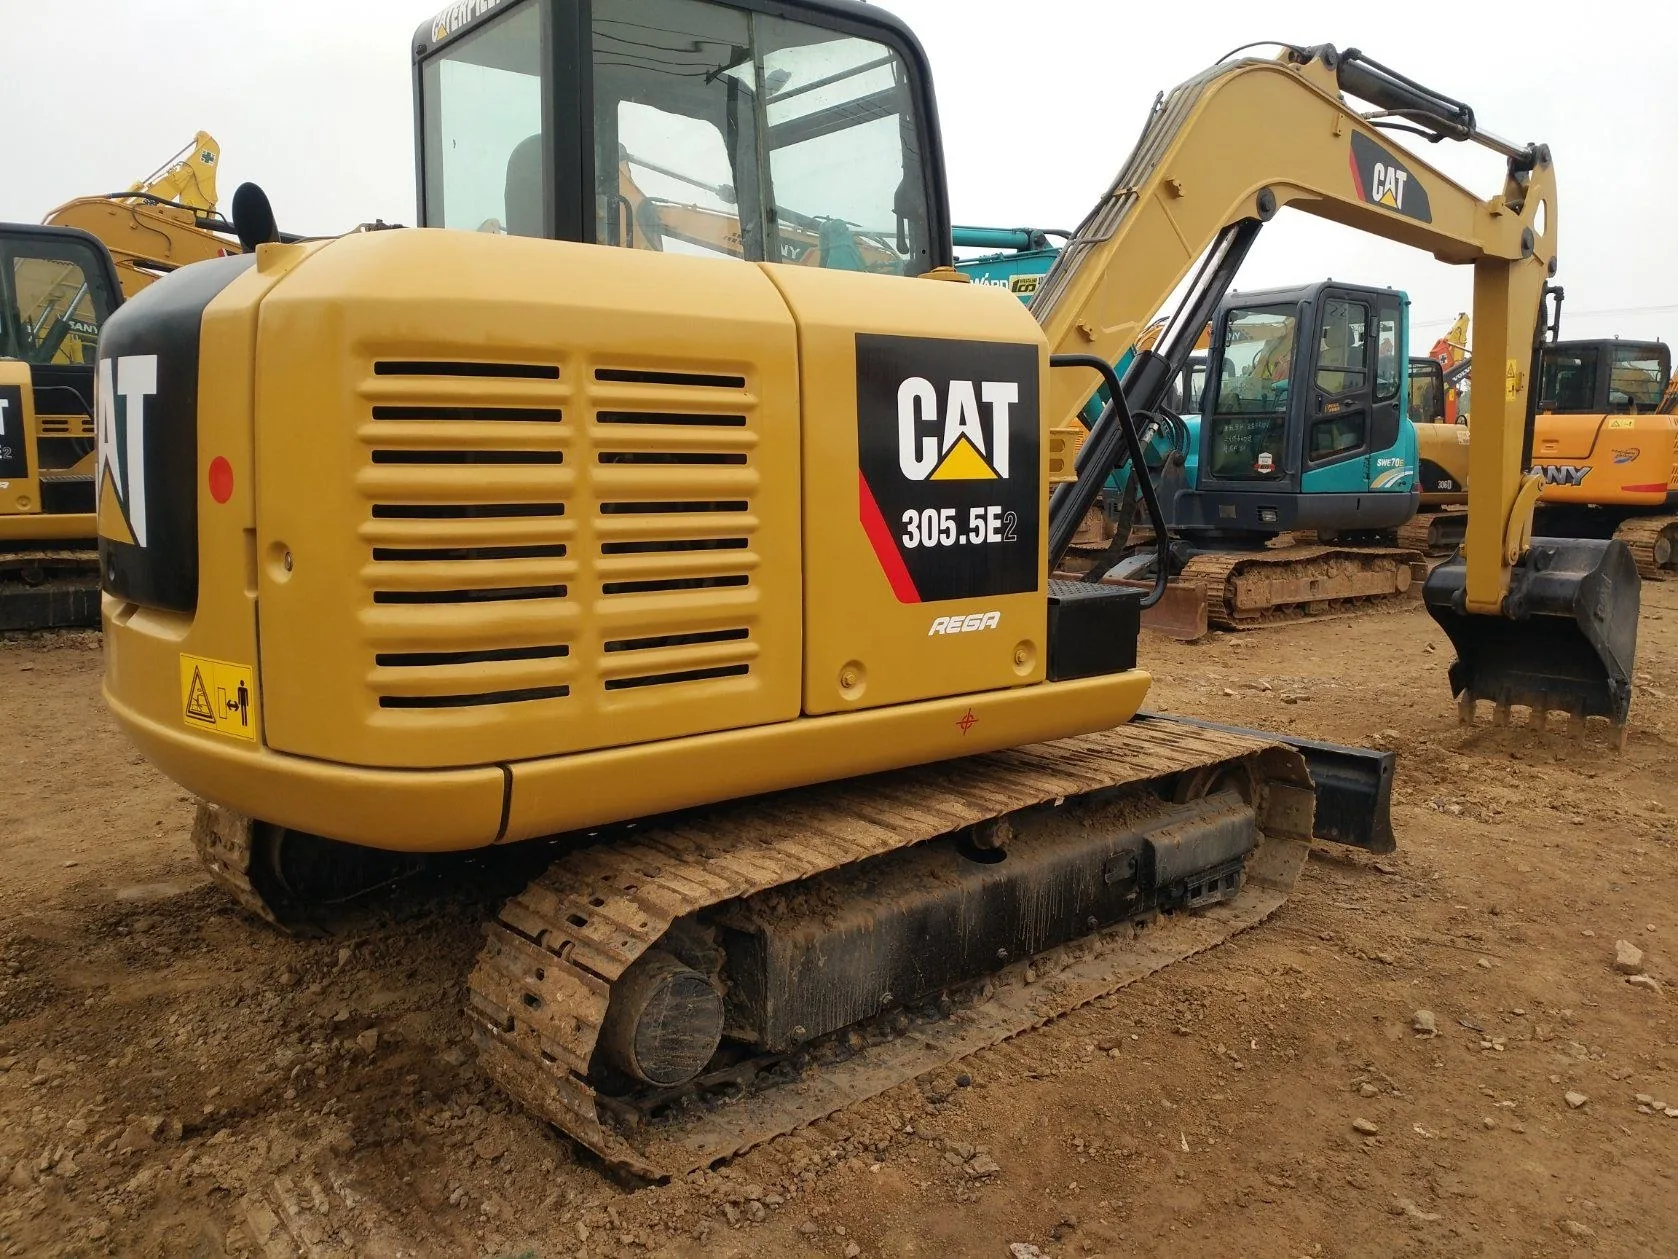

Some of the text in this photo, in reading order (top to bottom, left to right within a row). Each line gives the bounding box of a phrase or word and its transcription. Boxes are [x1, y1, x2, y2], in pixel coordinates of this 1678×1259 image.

[1372, 162, 1407, 210] CAT
[95, 354, 158, 548] AT
[897, 376, 1019, 481] CAT
[1523, 464, 1593, 487] ANY
[901, 505, 1018, 549] 305.5E2
[928, 611, 1001, 636] REGA
